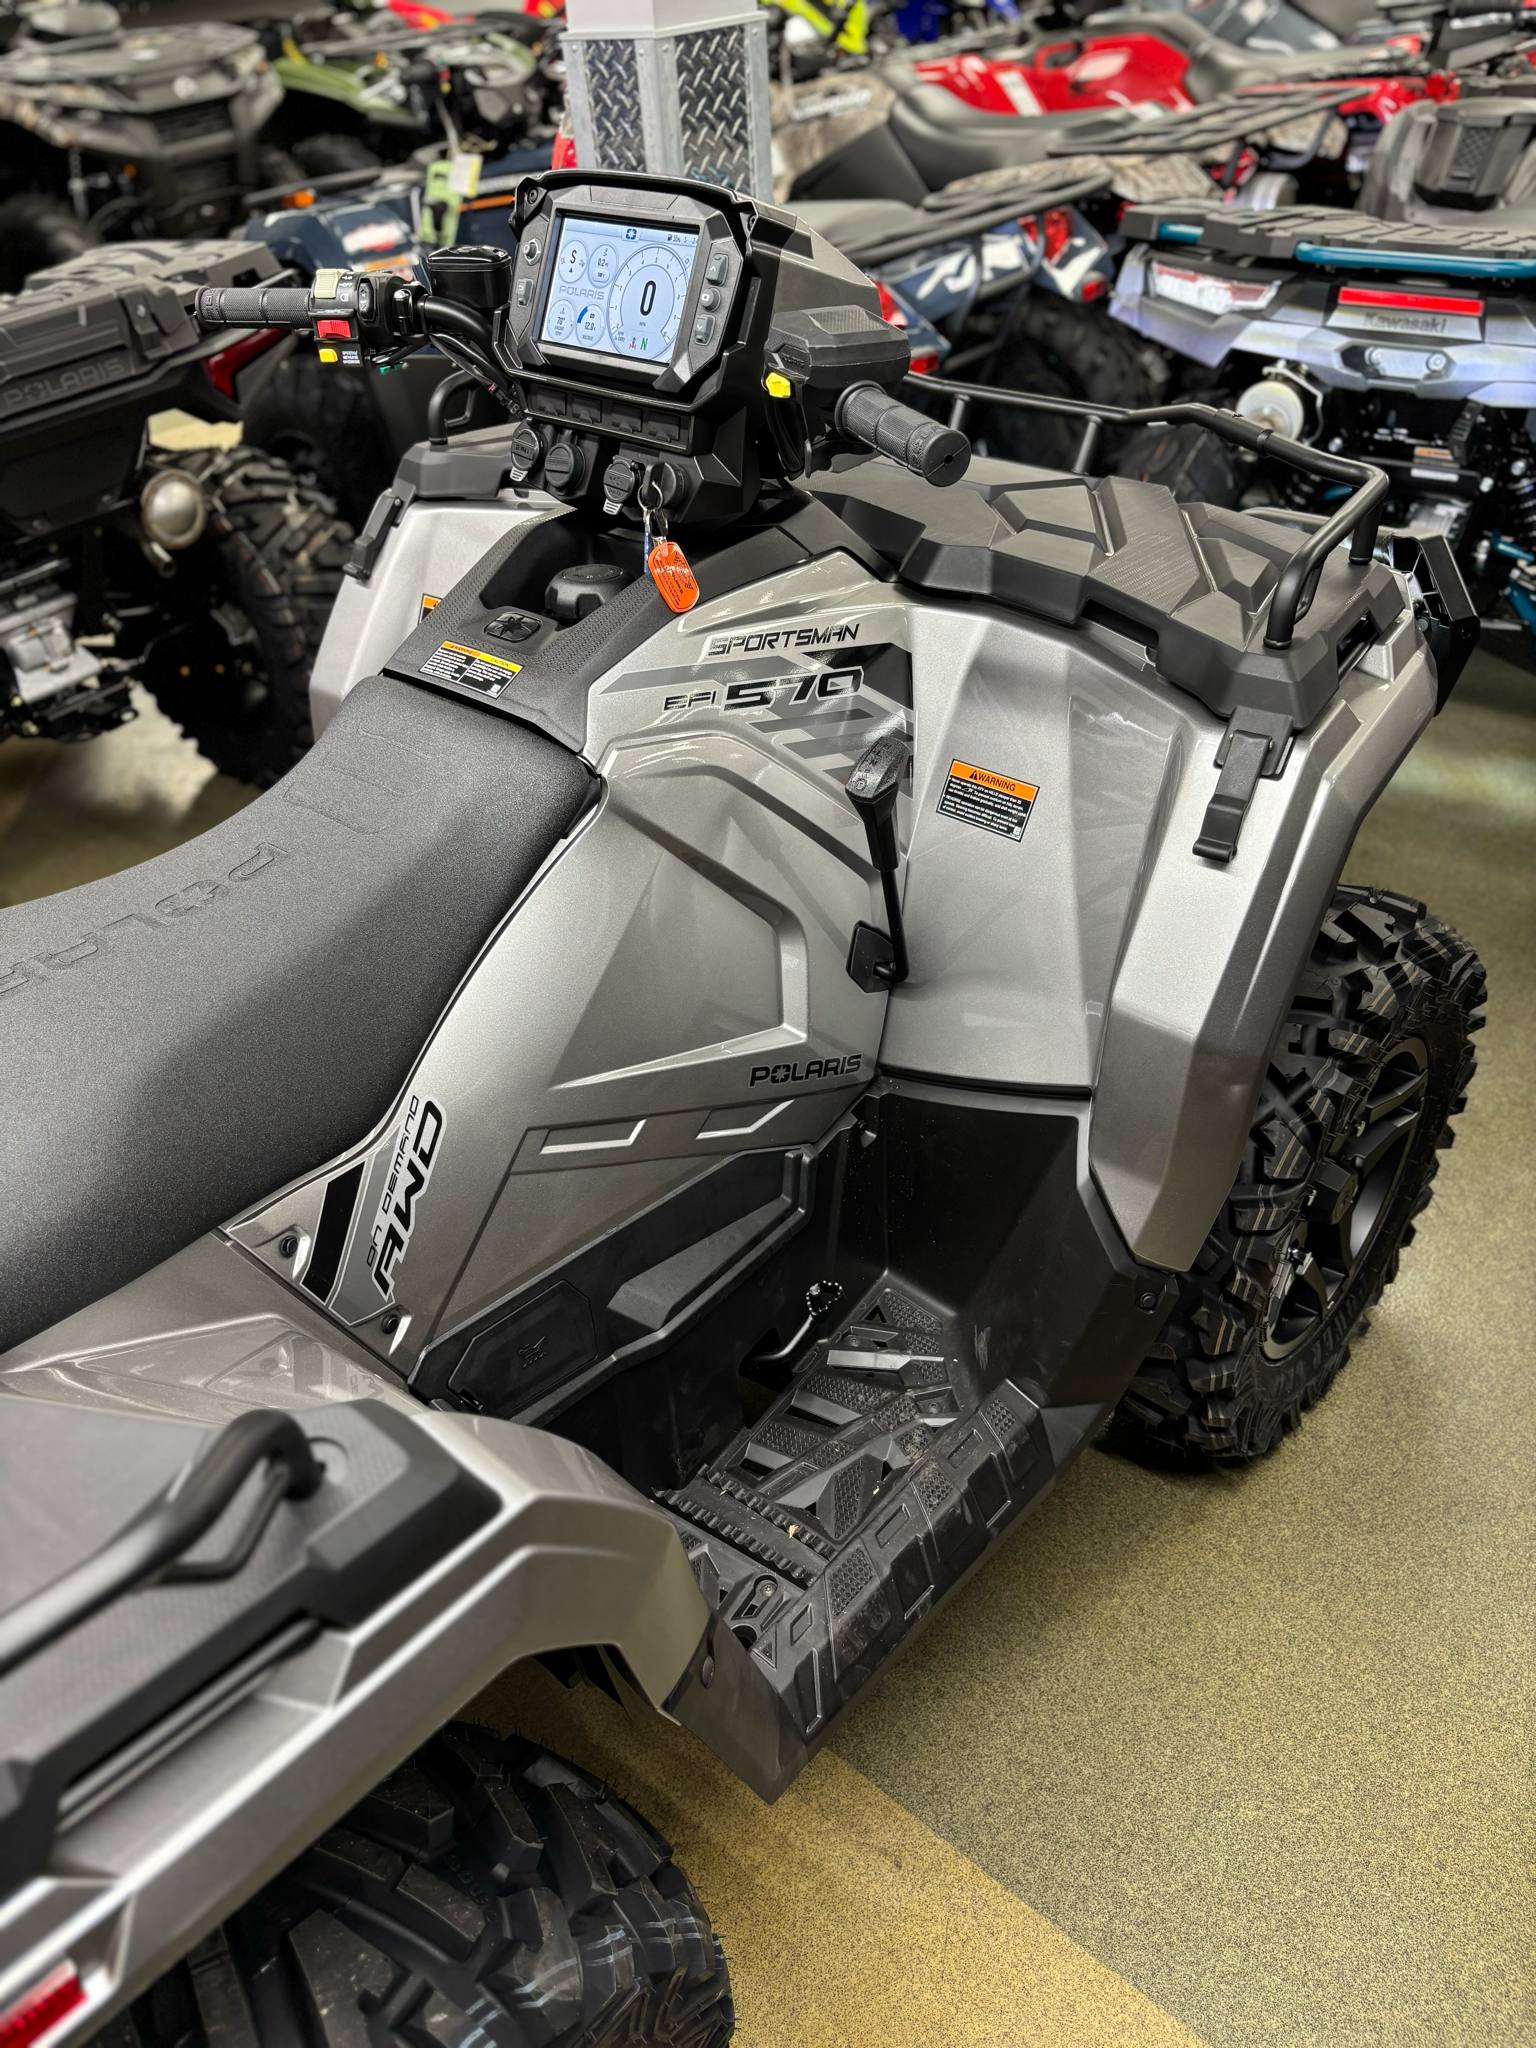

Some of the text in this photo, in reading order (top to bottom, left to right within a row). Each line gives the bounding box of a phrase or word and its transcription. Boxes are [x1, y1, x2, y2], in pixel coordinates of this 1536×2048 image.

[570, 249, 577, 264] S
[558, 285, 604, 300] POLARIS
[640, 280, 656, 316] 0
[640, 337, 648, 350] N
[708, 624, 860, 656] SPORTSMAN
[664, 666, 864, 712] EFI 570
[978, 772, 1016, 792] WARNING
[749, 1054, 862, 1087] POLARIS
[382, 1094, 420, 1215] DEMAND
[374, 1100, 443, 1297] AWD
